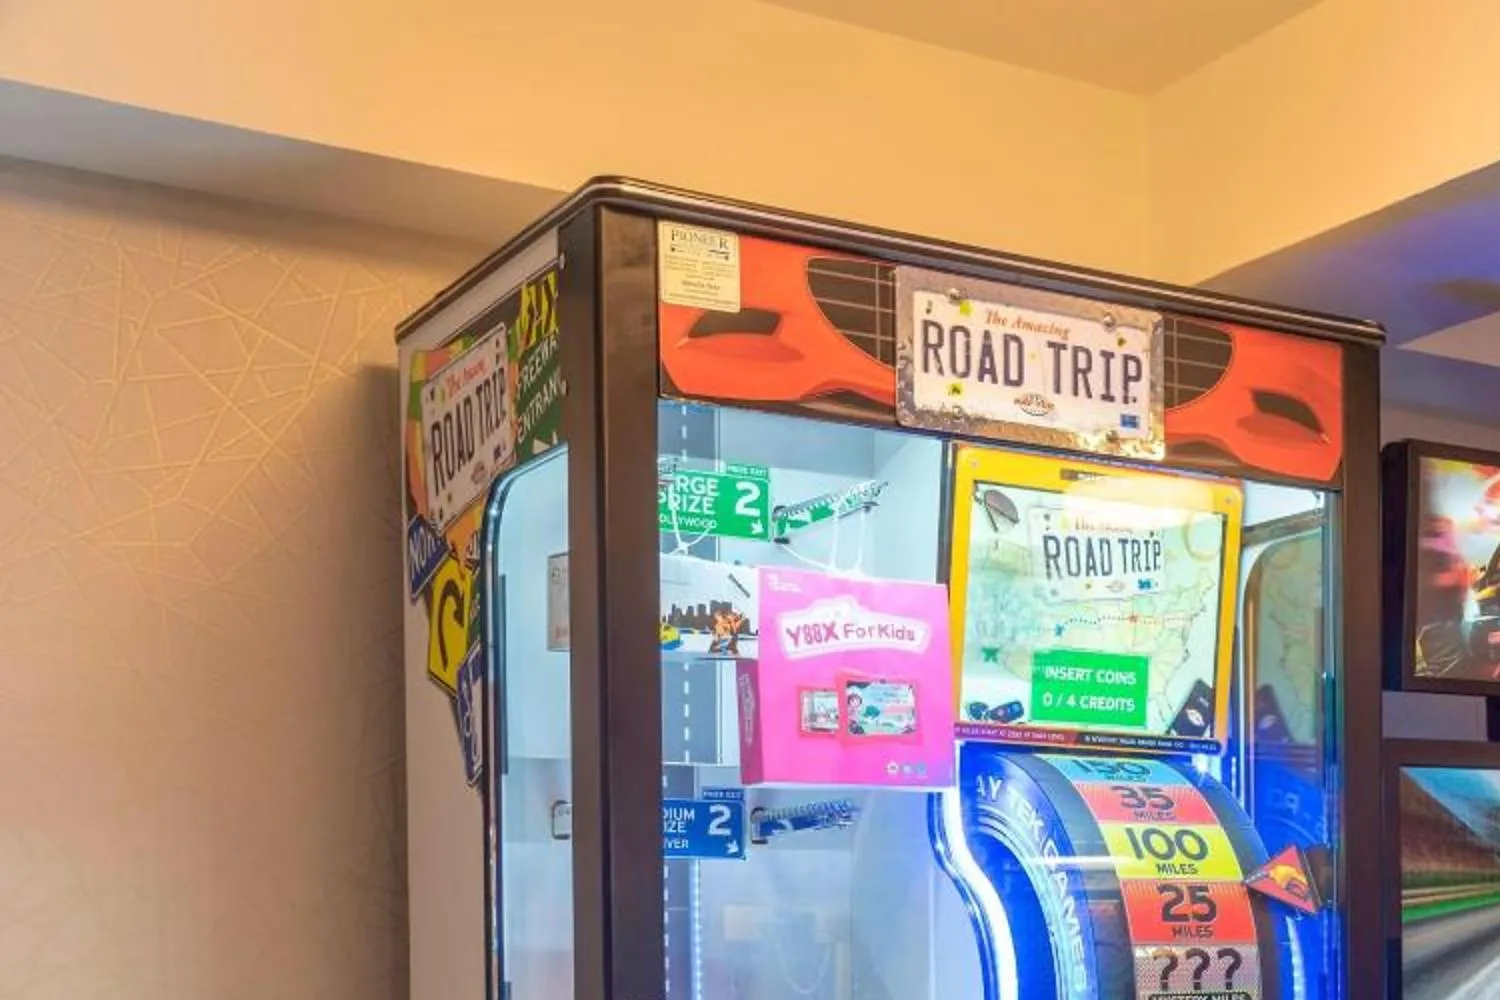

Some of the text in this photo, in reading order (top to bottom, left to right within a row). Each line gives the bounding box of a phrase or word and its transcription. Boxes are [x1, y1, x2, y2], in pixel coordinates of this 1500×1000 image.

[984, 307, 1071, 341] The Amazing
[921, 318, 1143, 405] ROAD TRIP
[431, 367, 506, 496] ROAD TRIP
[675, 475, 721, 498] RGE
[736, 480, 761, 517] 2
[1043, 534, 1162, 580] ROAD TRIP
[843, 622, 878, 641] For
[878, 623, 917, 642] Kids
[1044, 665, 1138, 686] INSERT COINS
[1066, 693, 1078, 707] 4
[1079, 693, 1136, 713] CREDITS
[1110, 785, 1176, 811] 35
[708, 804, 731, 837] 2
[1134, 810, 1176, 822] MILES
[1124, 826, 1209, 861] 100
[1155, 862, 1200, 876] MILES
[1157, 882, 1218, 924] 25
[1172, 925, 1214, 939] MILES
